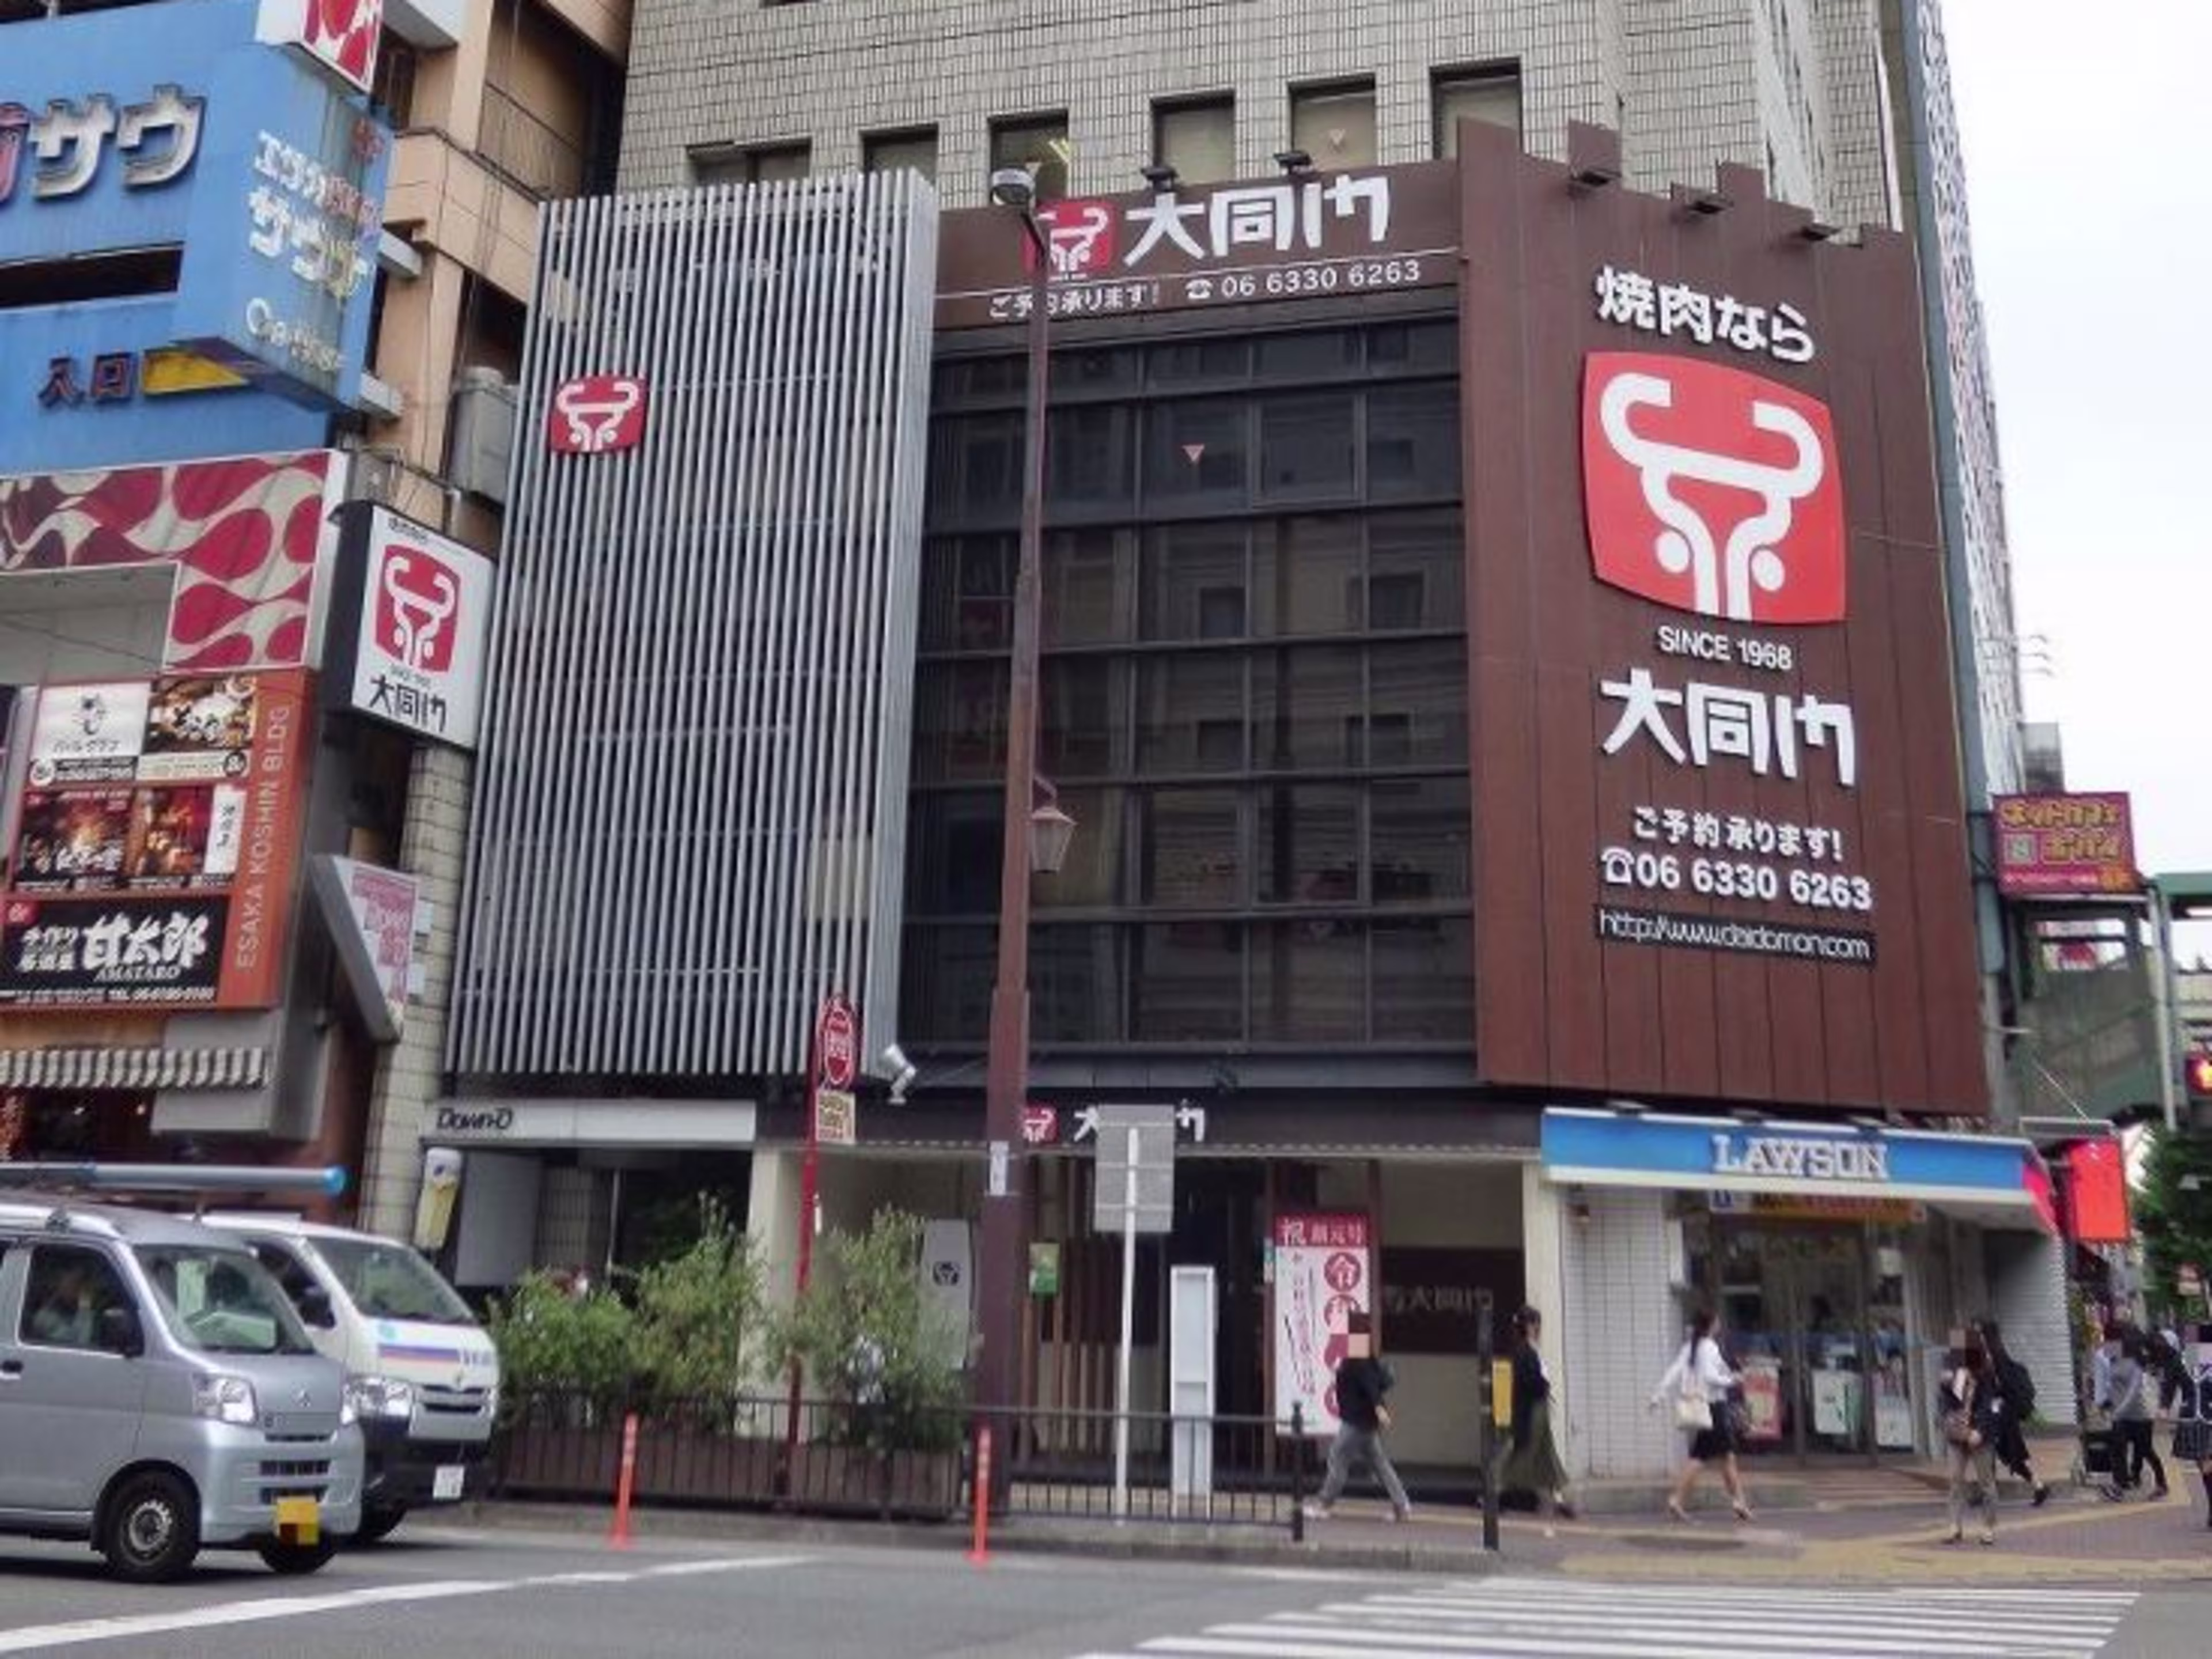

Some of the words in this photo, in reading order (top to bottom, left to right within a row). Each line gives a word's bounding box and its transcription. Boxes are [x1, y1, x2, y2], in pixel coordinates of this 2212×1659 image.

[1221, 271, 1256, 298] 06
[1266, 266, 1338, 294] 6330
[1347, 259, 1422, 287] 6263
[1594, 265, 1815, 363] 焼肉なら
[38, 353, 137, 408] 入口
[1658, 625, 1732, 661] SINCE
[1737, 637, 1793, 670] 1968
[262, 706, 290, 773] BLDG
[249, 781, 279, 877] KOSHIN
[1634, 806, 1844, 862] ご予約承ります!
[1636, 854, 1681, 889] 06
[1691, 857, 1778, 901] 6330
[1790, 869, 1873, 911] 6263
[82, 912, 209, 970] 甘太郎
[237, 880, 264, 970] ESAKA
[93, 964, 180, 982] AMATARO
[1711, 1134, 1888, 1180] LAWSON
